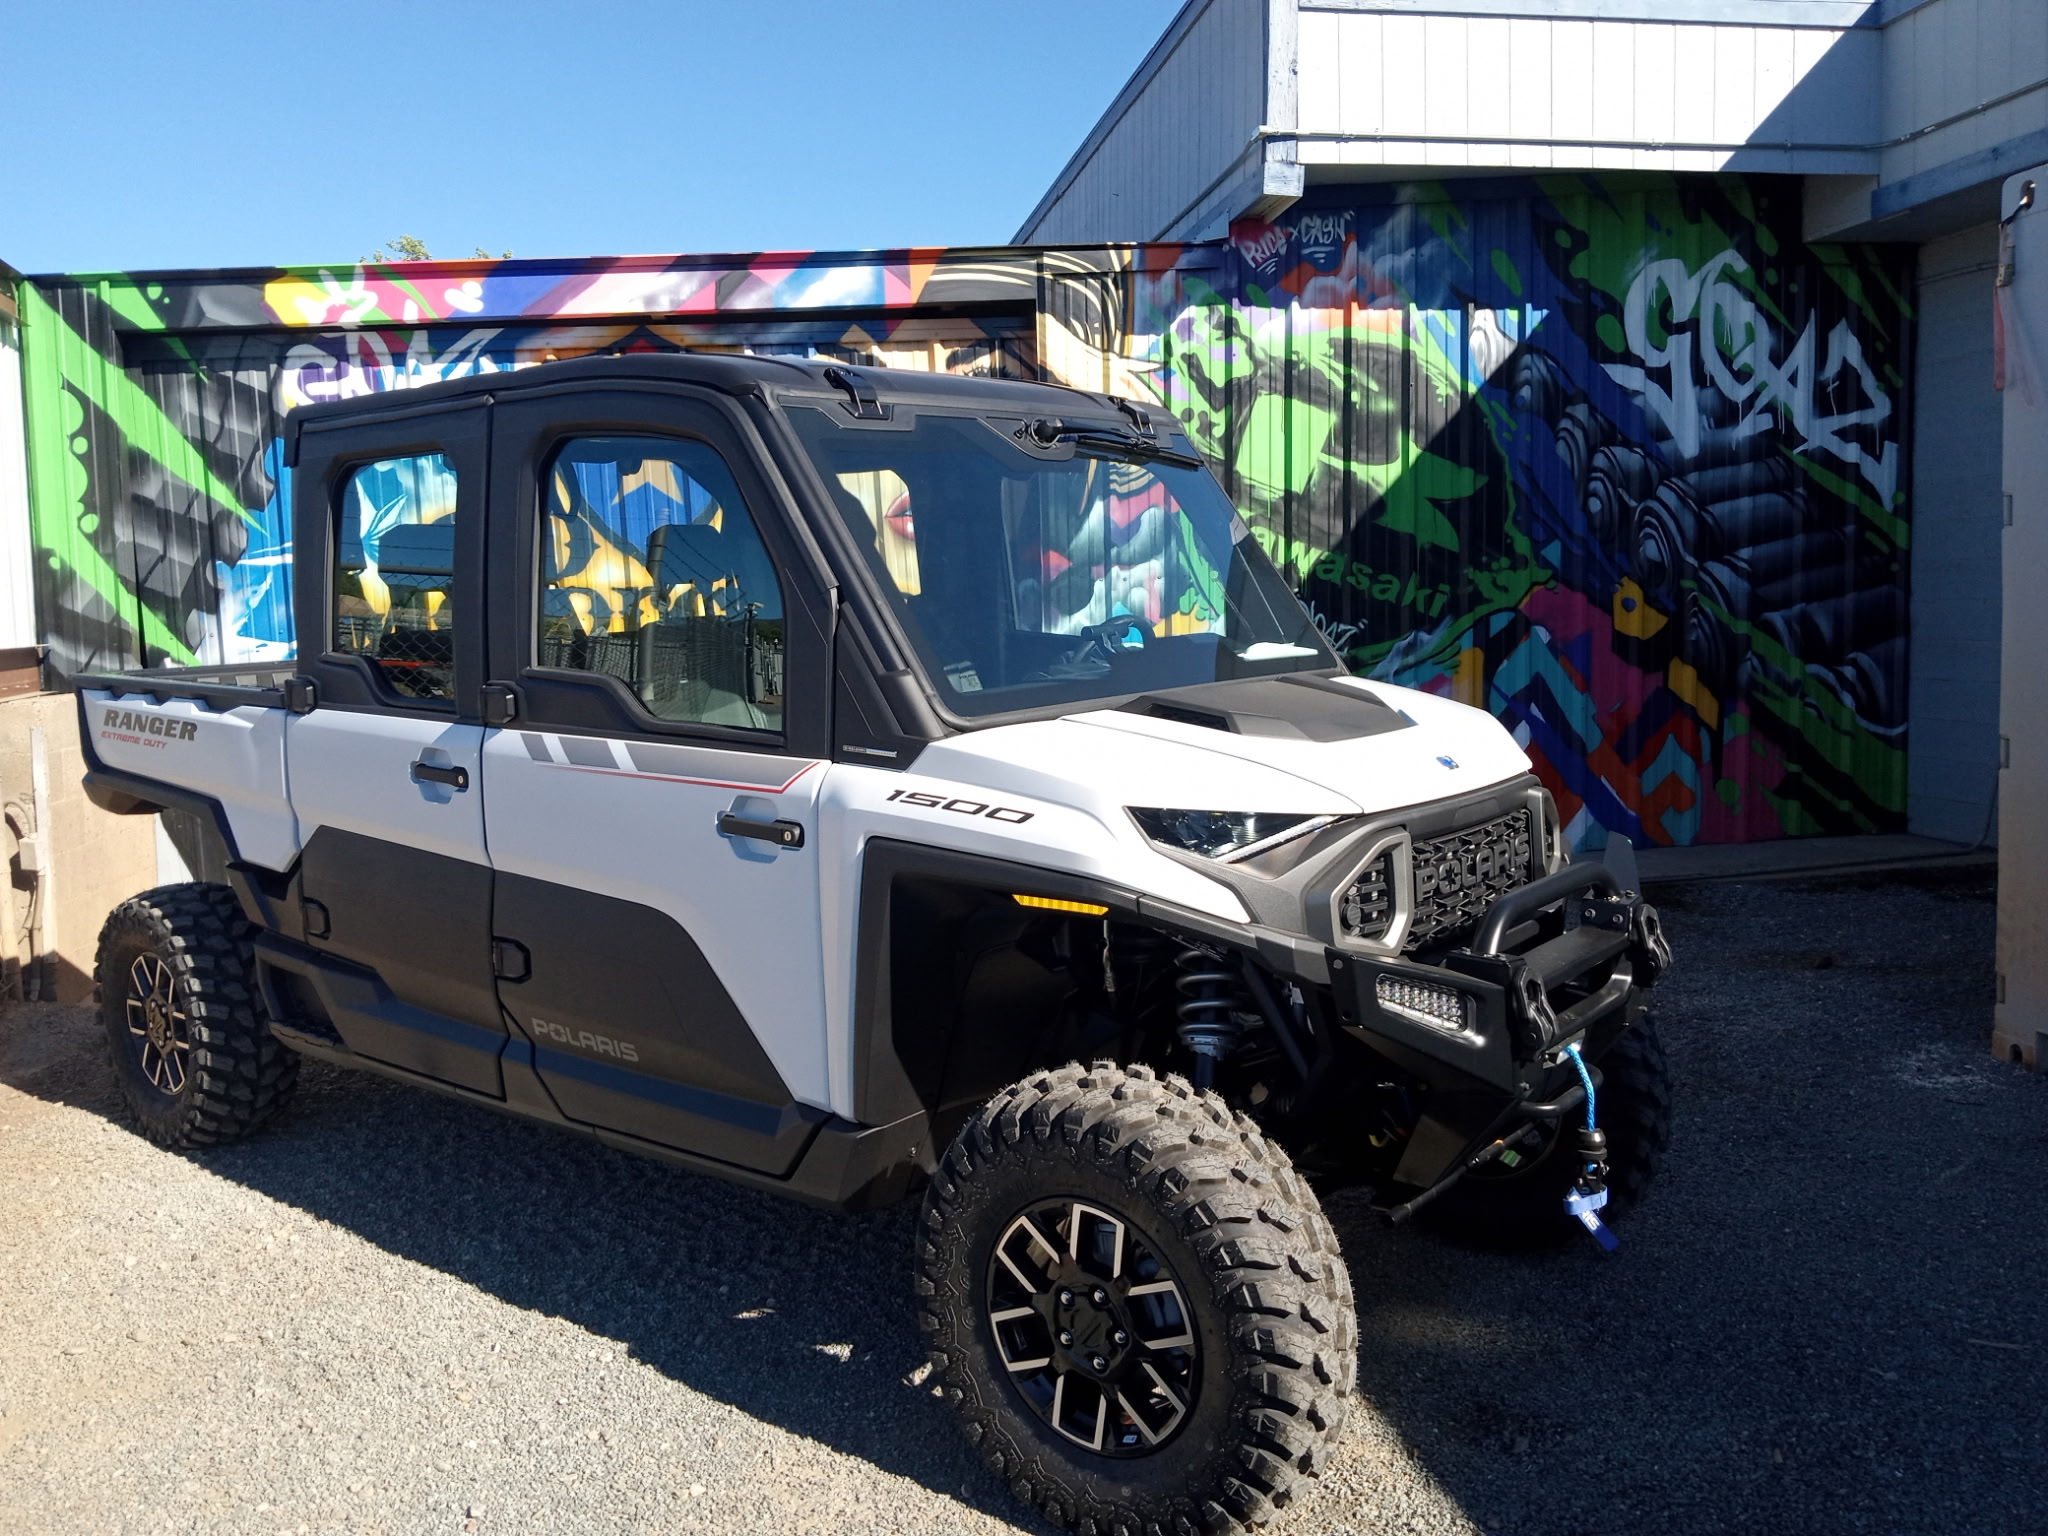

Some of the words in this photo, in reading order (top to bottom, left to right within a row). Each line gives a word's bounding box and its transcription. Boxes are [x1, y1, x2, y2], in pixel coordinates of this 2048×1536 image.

[1250, 525, 1450, 618] awasaki
[101, 730, 141, 745] EXTREME
[143, 738, 168, 749] DUTY
[103, 709, 198, 741] RANGER
[886, 789, 1035, 824] 1500
[1415, 832, 1530, 904] POLARIS
[532, 1018, 639, 1062] POLARIS
